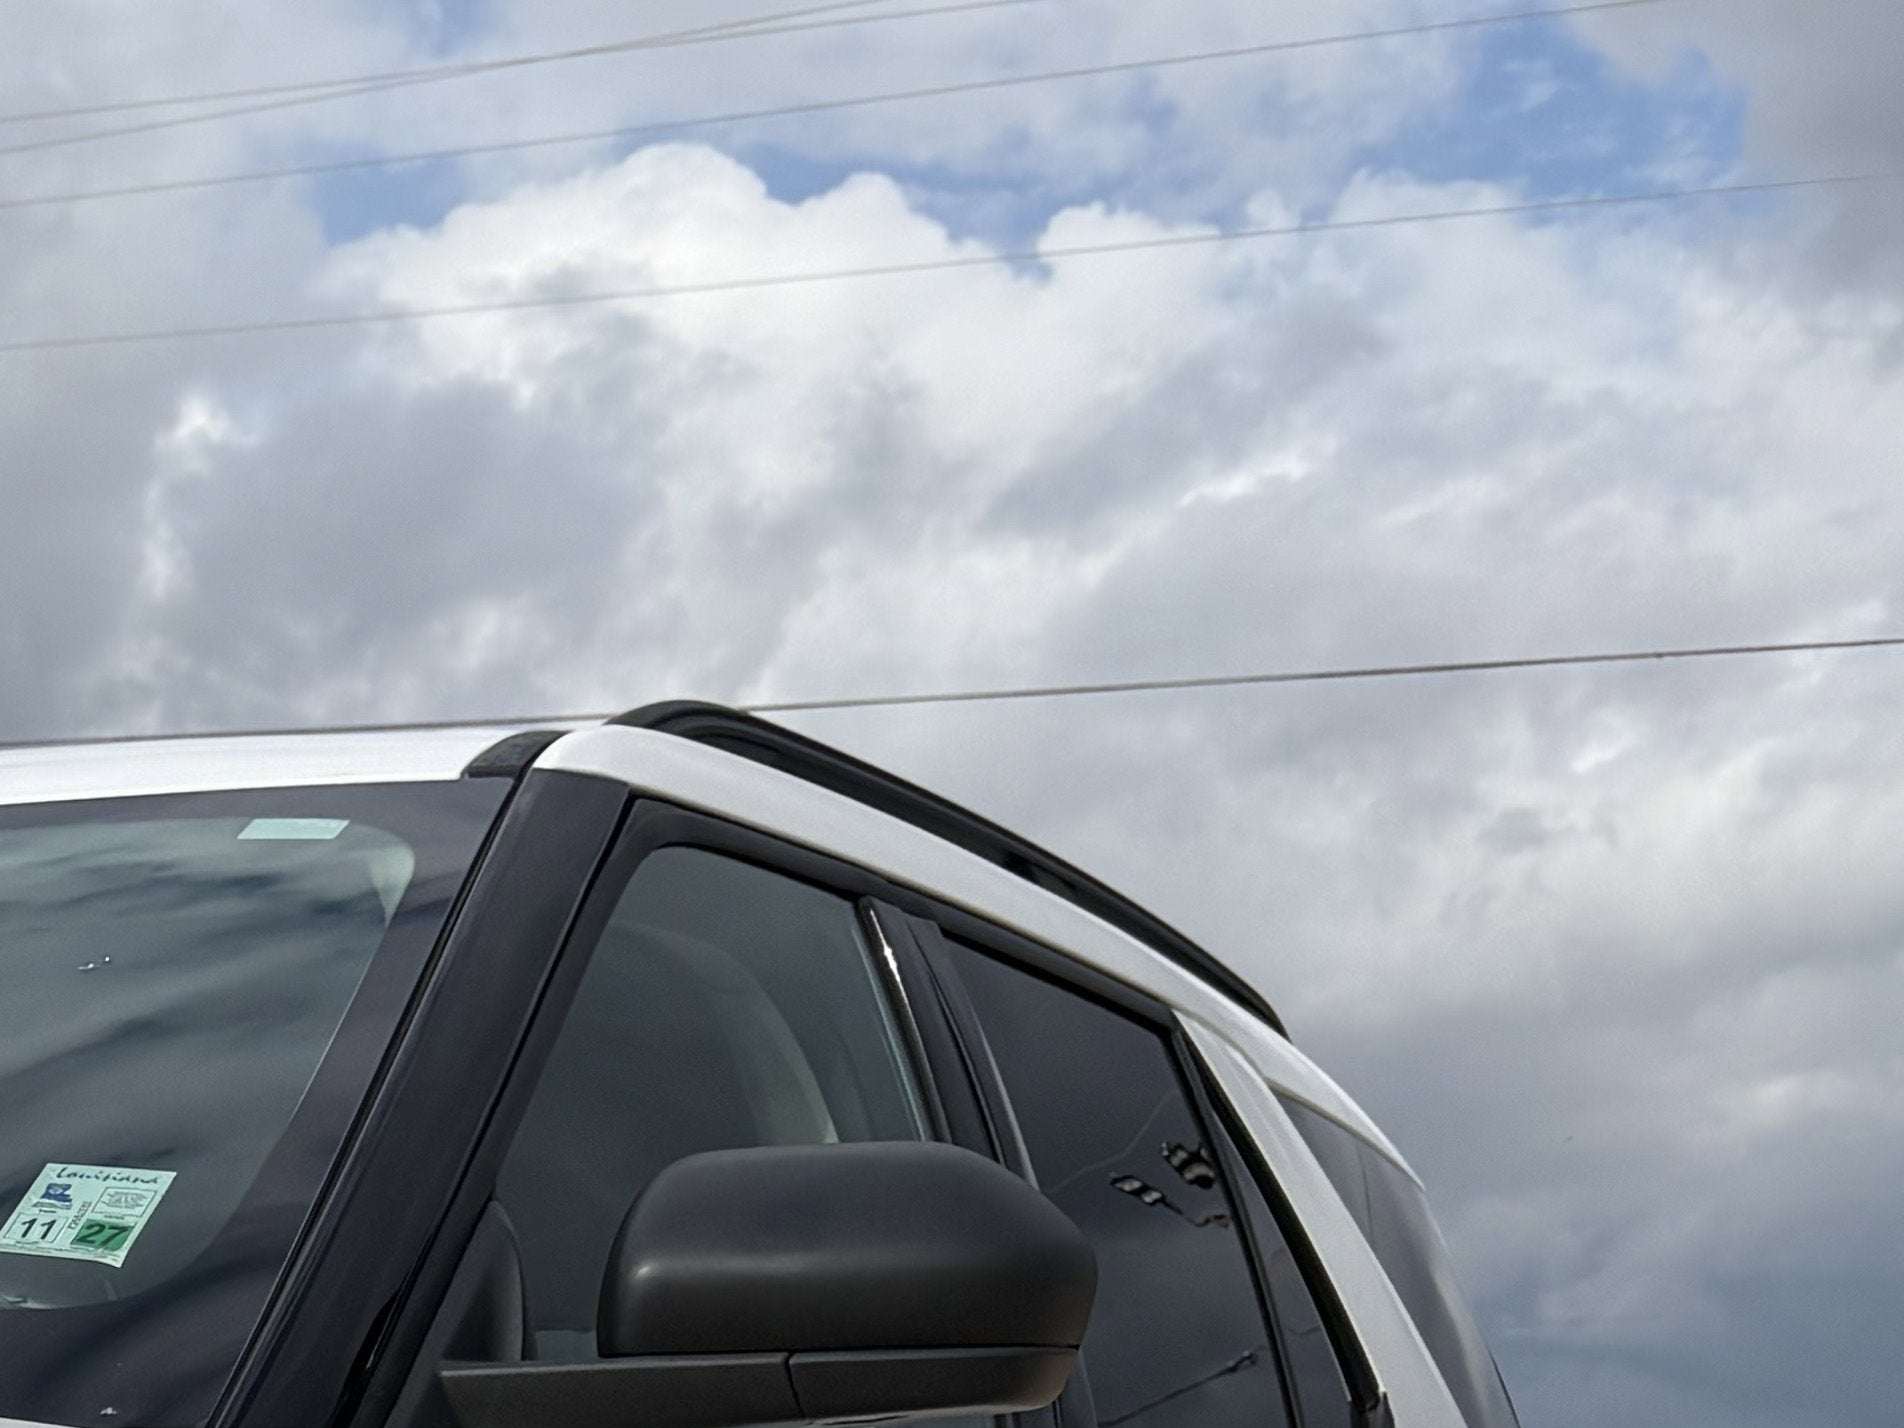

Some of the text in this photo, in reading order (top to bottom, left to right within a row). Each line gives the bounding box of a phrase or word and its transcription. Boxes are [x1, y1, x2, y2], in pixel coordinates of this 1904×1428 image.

[56, 1166, 160, 1185] Louisiana
[20, 1217, 58, 1241] 11
[76, 1223, 130, 1247] 27
